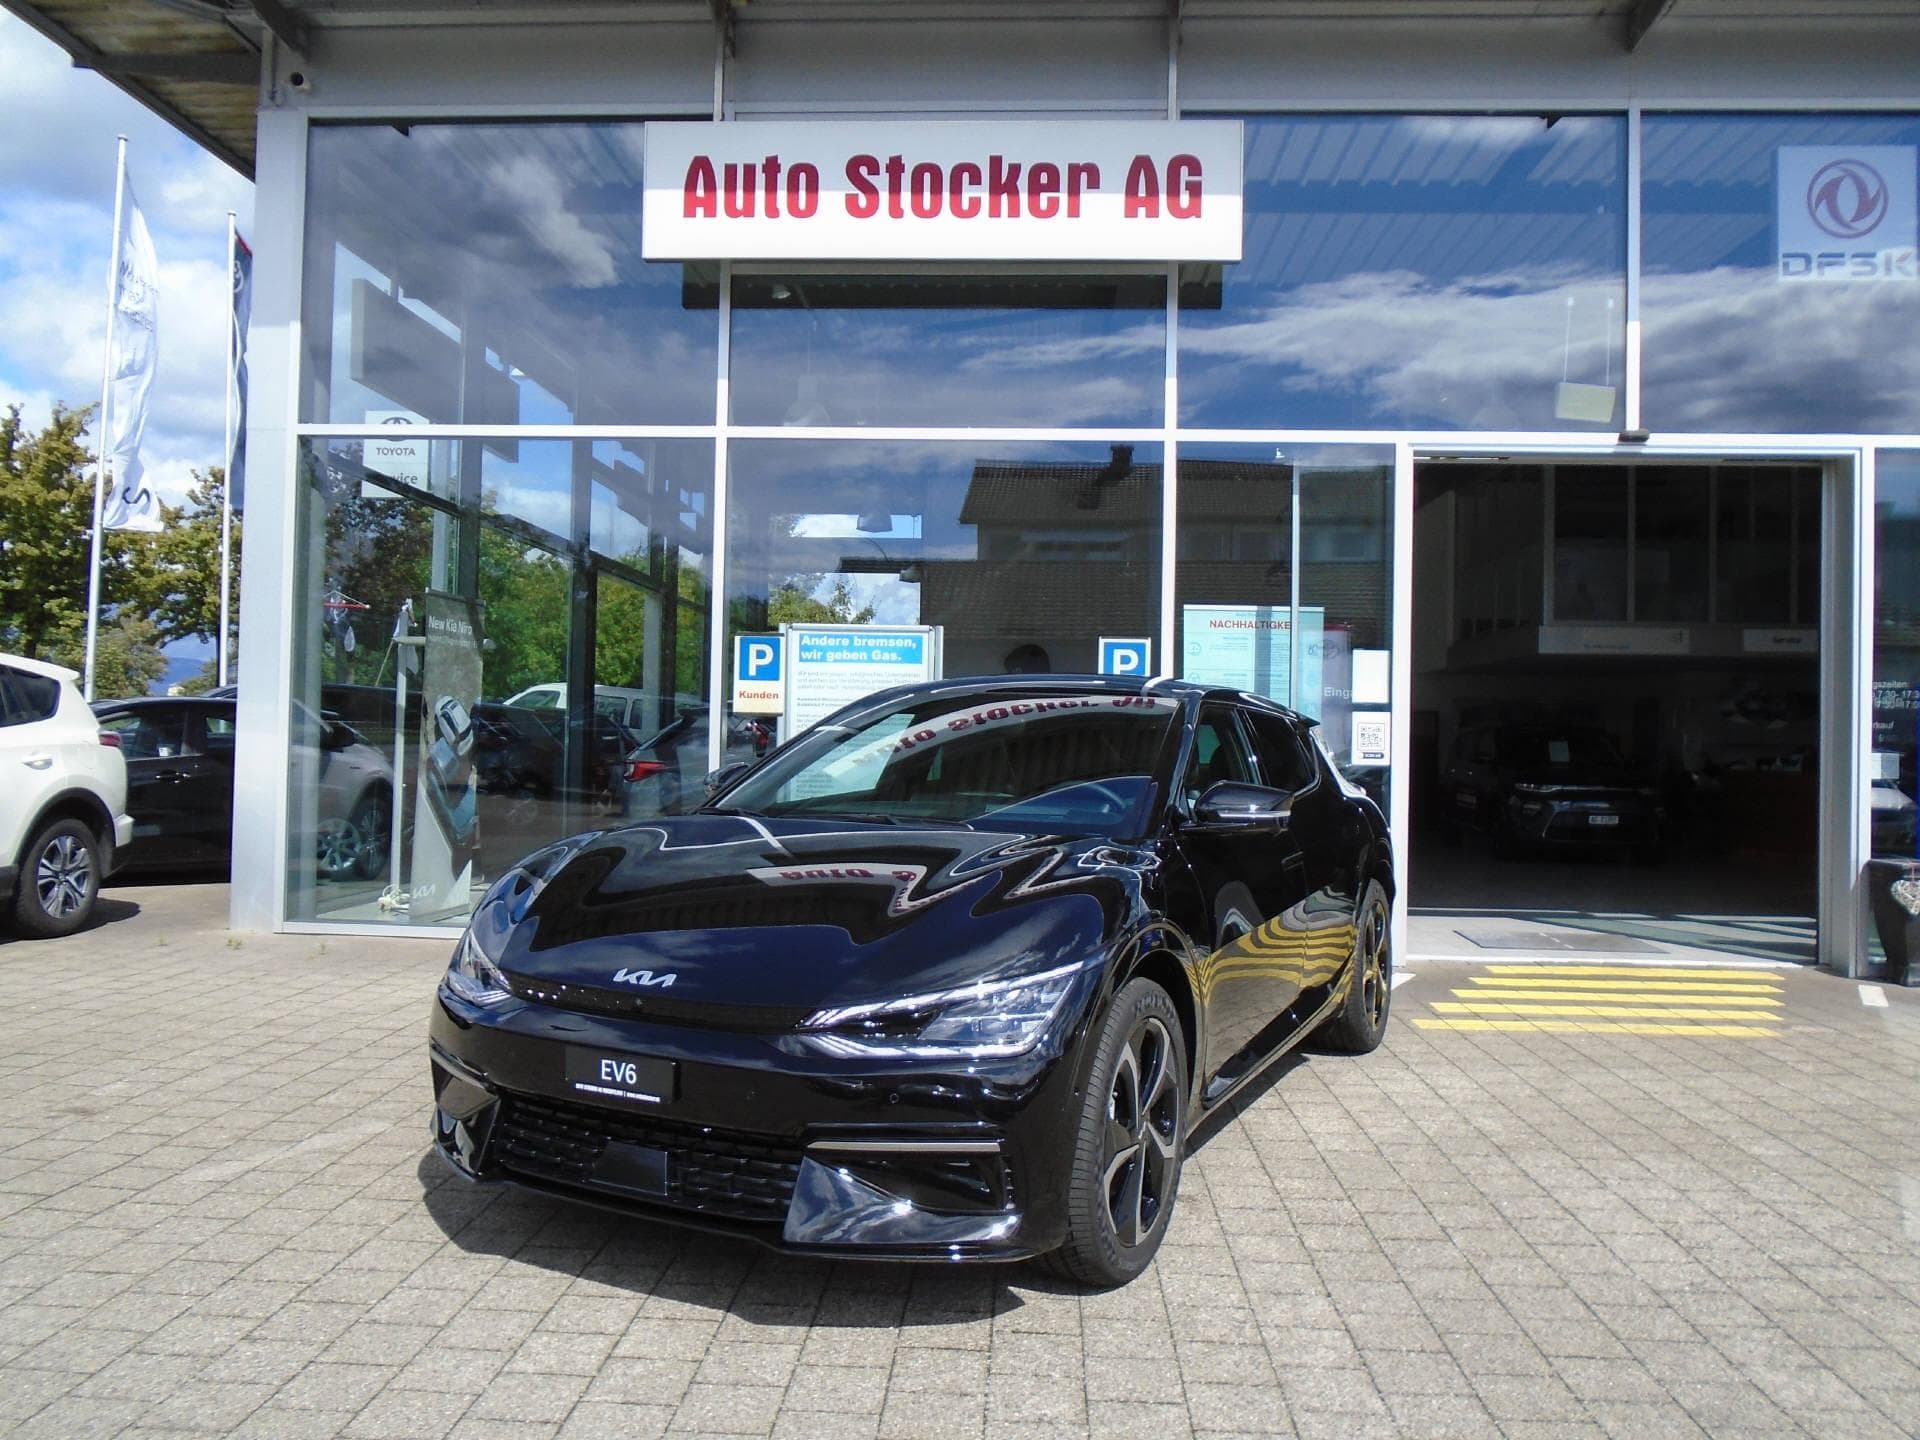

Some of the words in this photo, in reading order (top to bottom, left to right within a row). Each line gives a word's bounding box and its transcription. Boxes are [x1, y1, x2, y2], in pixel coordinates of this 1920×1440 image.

[683, 154, 820, 220] Auto
[844, 153, 1101, 220] Stocker
[1123, 153, 1203, 220] AG
[1782, 252, 1914, 276] DFSK
[375, 446, 417, 457] TOYOTA
[428, 615, 446, 631] New
[445, 618, 458, 633] Kia
[458, 620, 473, 636] Niro
[800, 634, 850, 647] Andere
[853, 635, 918, 650] bremsen,
[749, 643, 774, 677] P
[800, 648, 824, 661] wir
[826, 649, 869, 662] geben
[871, 649, 903, 661] Gas.
[1112, 648, 1139, 675] P
[738, 690, 780, 700] Kunden
[1323, 686, 1353, 700] Eing
[601, 1058, 637, 1085] EV6
